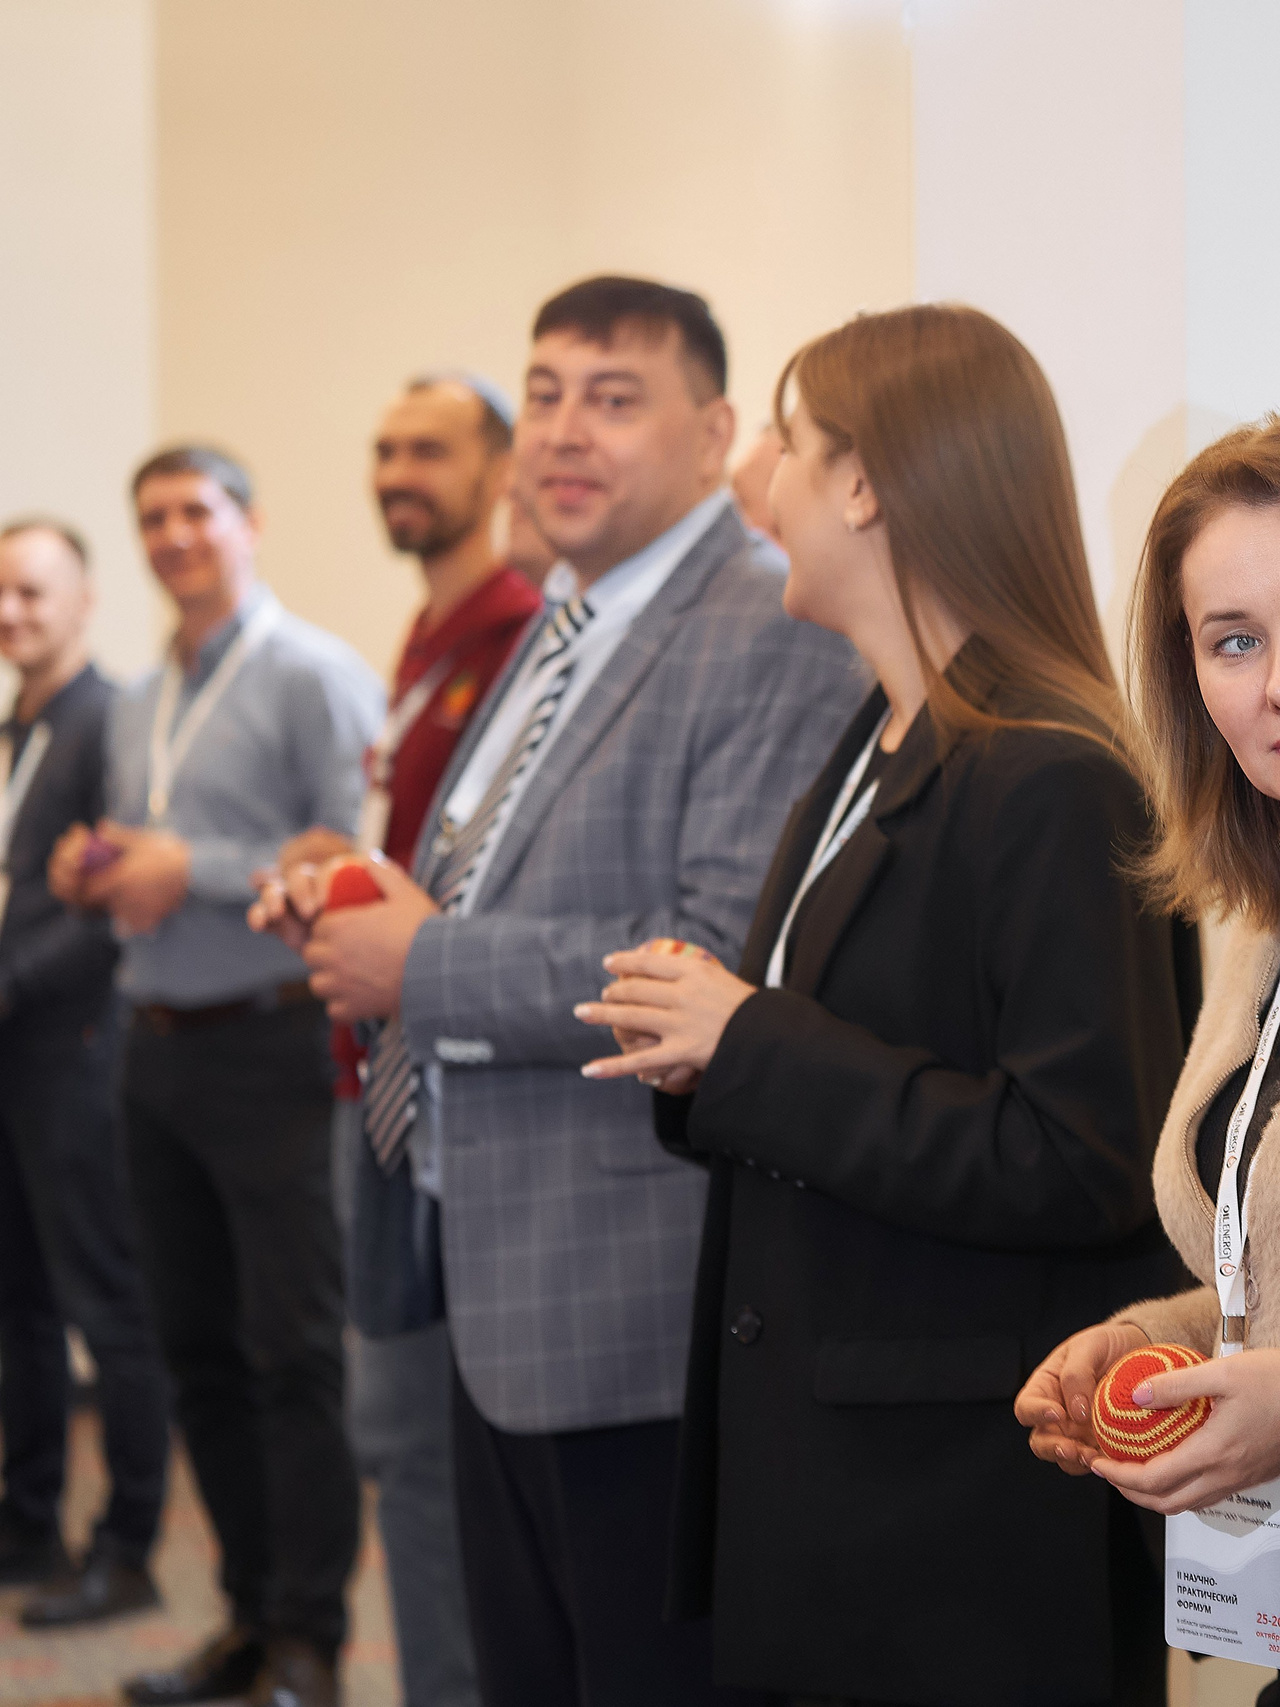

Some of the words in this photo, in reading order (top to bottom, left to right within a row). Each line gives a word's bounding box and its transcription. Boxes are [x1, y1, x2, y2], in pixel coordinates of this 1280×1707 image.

[1222, 1204, 1231, 1223] OIL
[1219, 1223, 1232, 1261] ENERGY
[1183, 1572, 1218, 1586] НАУЧНО-
[1177, 1585, 1238, 1605] ПРАКТИЧЕСКИЙ
[1177, 1599, 1212, 1614] ФОРМУМ
